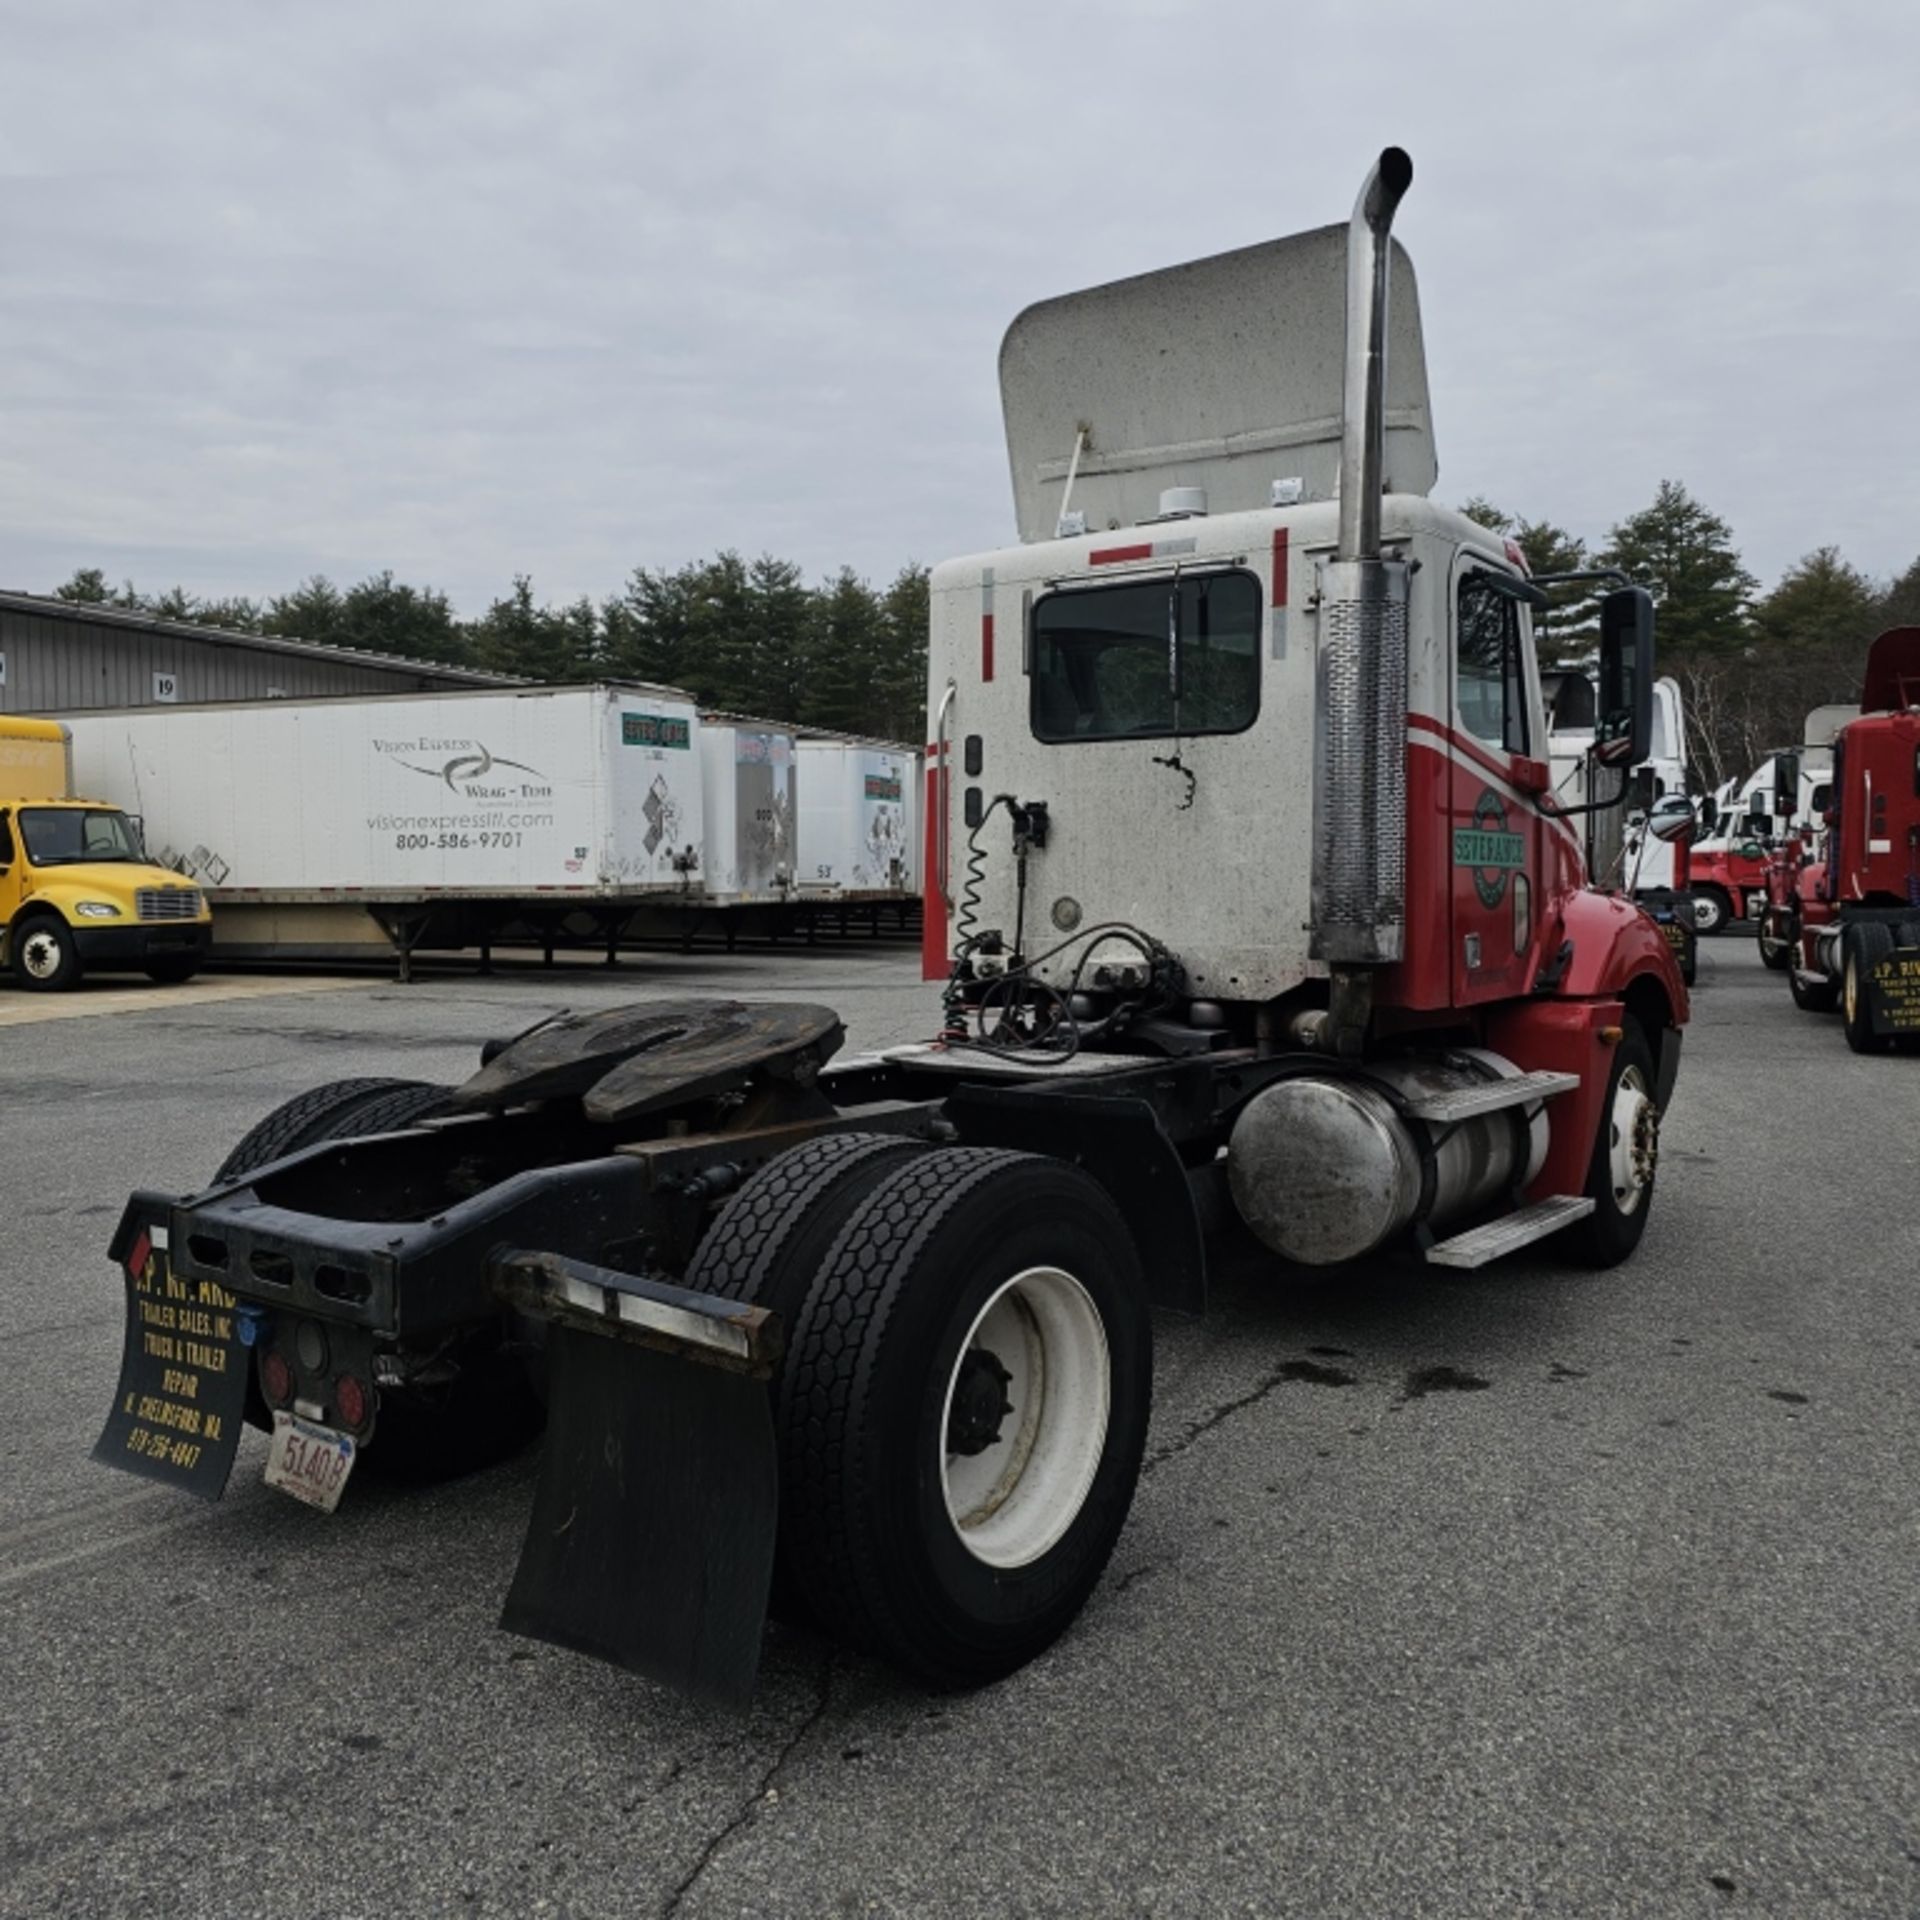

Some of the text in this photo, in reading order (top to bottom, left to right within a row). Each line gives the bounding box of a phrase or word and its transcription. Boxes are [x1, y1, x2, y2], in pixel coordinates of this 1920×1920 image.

[158, 678, 174, 696] 19
[395, 831, 523, 851] 800-586-9701
[139, 1299, 177, 1330] TRAILER
[143, 1331, 173, 1360] TRUCK
[185, 1340, 227, 1373] TRAILER
